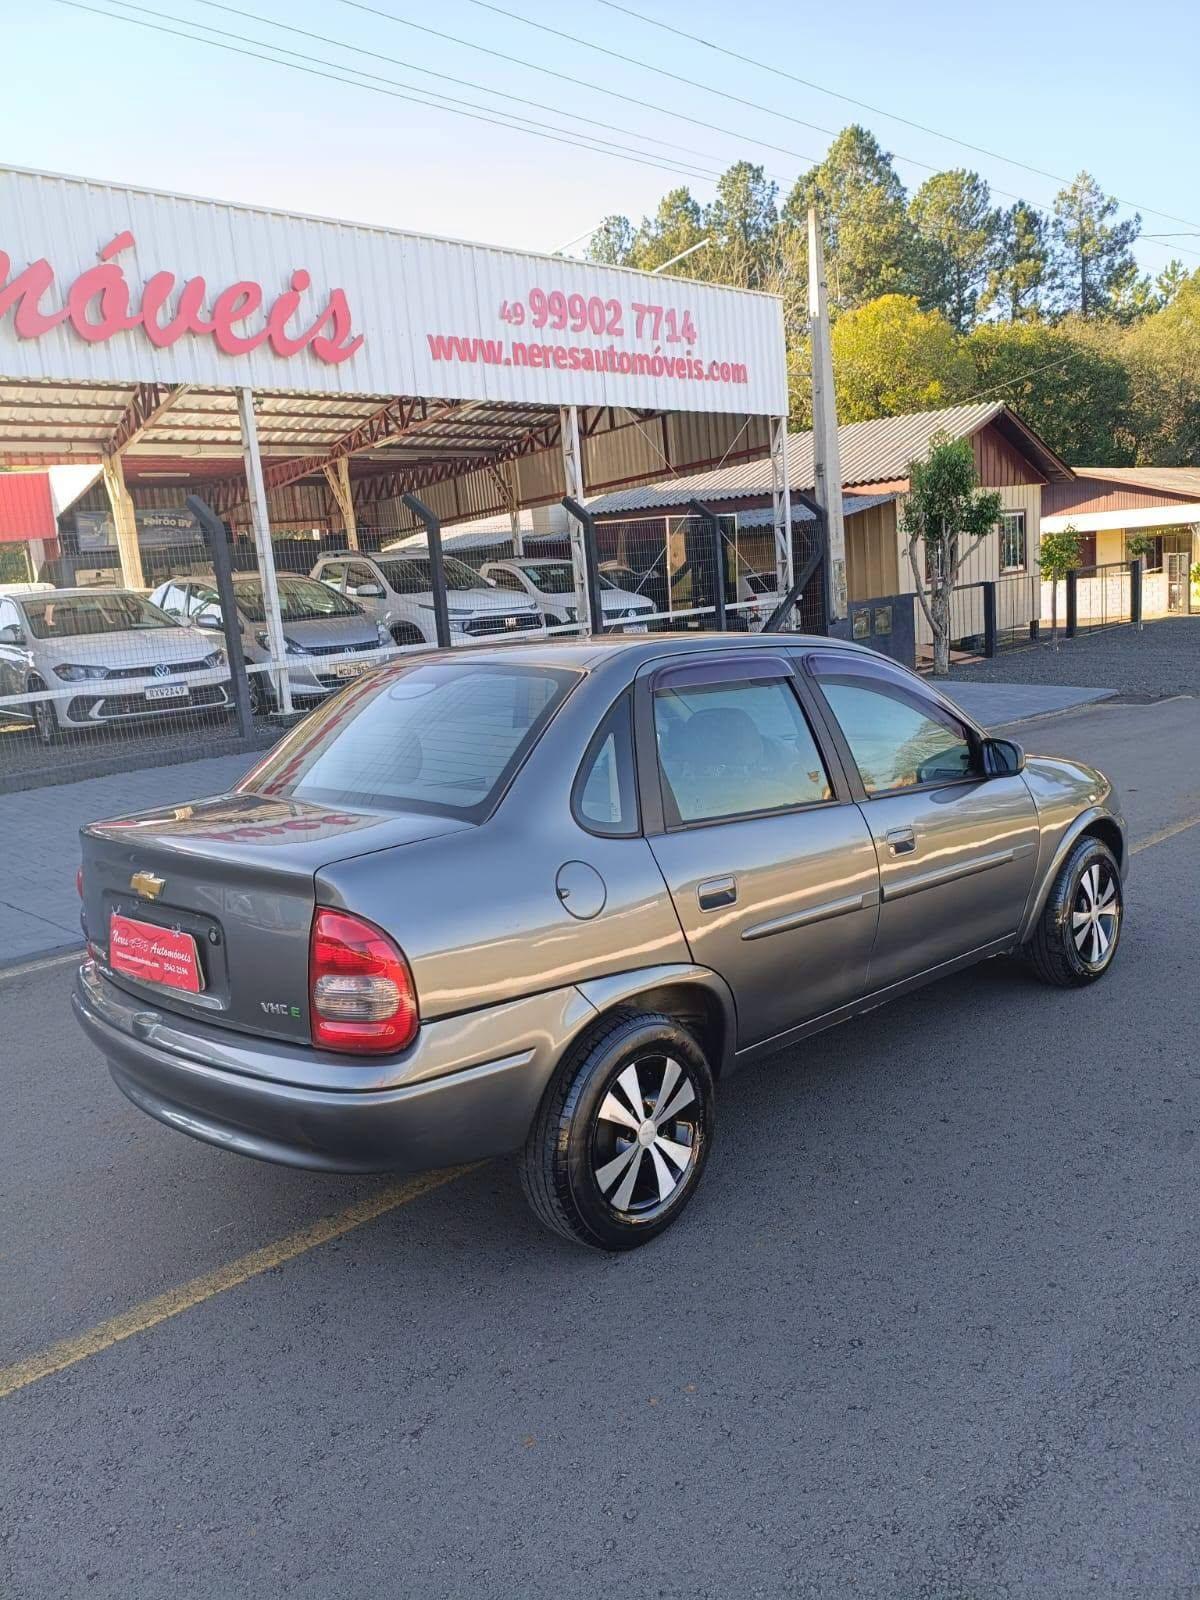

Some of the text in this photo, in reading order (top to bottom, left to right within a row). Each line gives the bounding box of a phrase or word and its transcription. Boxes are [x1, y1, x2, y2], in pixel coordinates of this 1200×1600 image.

[500, 287, 697, 345] 49 99902 7714
[426, 334, 748, 384] www.neresautomóveis.com
